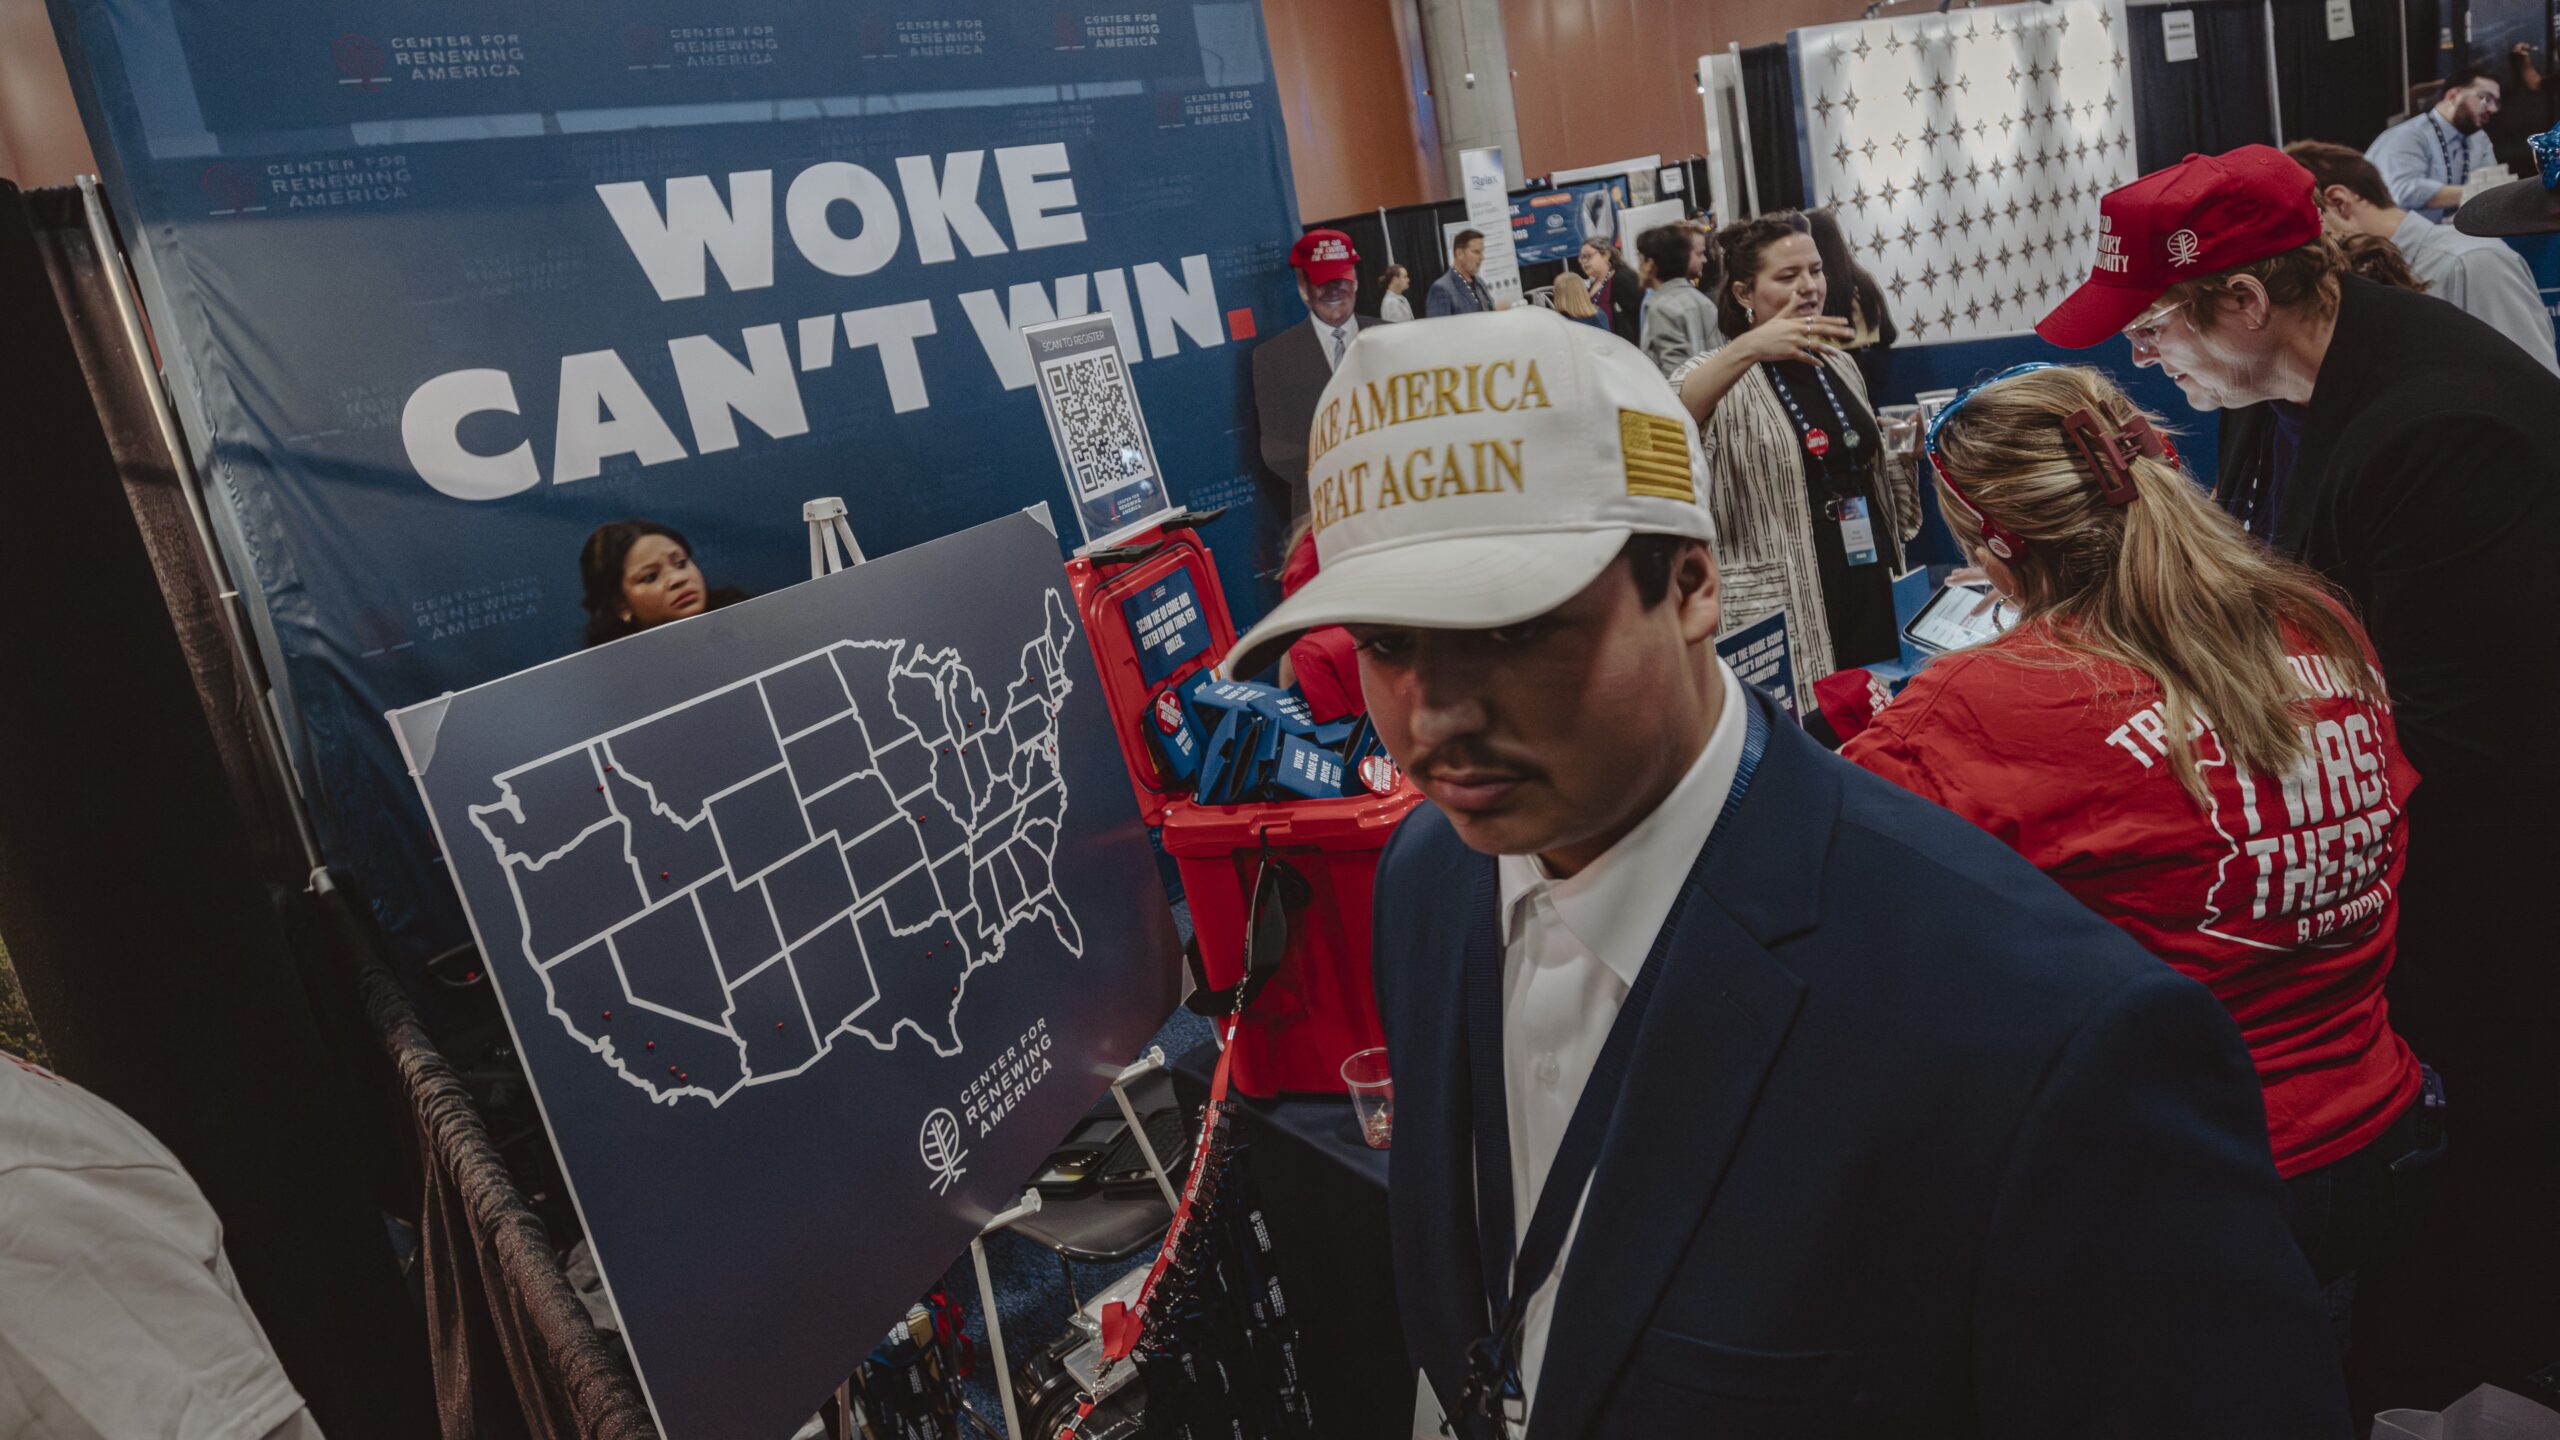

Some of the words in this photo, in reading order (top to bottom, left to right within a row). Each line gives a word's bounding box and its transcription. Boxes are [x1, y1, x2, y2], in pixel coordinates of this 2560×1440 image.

[1084, 14, 1131, 25] CENTER
[1135, 13, 1158, 23] FOR
[1087, 24, 1160, 37] RENEWING
[391, 35, 472, 49] CENTER
[481, 34, 520, 45] FOR
[1096, 36, 1158, 48] AMERICA
[395, 48, 524, 65] RENEWING
[411, 64, 521, 81] AMERICA
[267, 158, 354, 176] CENTER
[365, 155, 406, 167] FOR
[271, 168, 412, 193] RENEWING
[289, 186, 408, 208] AMERICA
[594, 142, 1087, 301] WOKE
[1042, 339, 1063, 353] SCAN
[1062, 337, 1074, 348] TO
[1073, 330, 1105, 346] REGISTER
[401, 299, 937, 500] CAN'T
[958, 254, 1256, 391] WIN.
[1344, 359, 1552, 439] AMERICA
[1378, 439, 1525, 510] AGAIN
[1136, 615, 1153, 634] SCAN
[1142, 630, 1160, 651] ENTER
[1293, 749, 1305, 770] WOKE
[1310, 752, 1319, 763] US
[1305, 762, 1318, 781] MADE
[1319, 760, 1332, 784] BROKE
[2281, 713, 2383, 828] WAS
[960, 1047, 1017, 1105] CENTER
[1020, 1017, 1047, 1048] FOR
[965, 1034, 1052, 1126] RENEWING
[980, 1058, 1053, 1139] AMERICA
